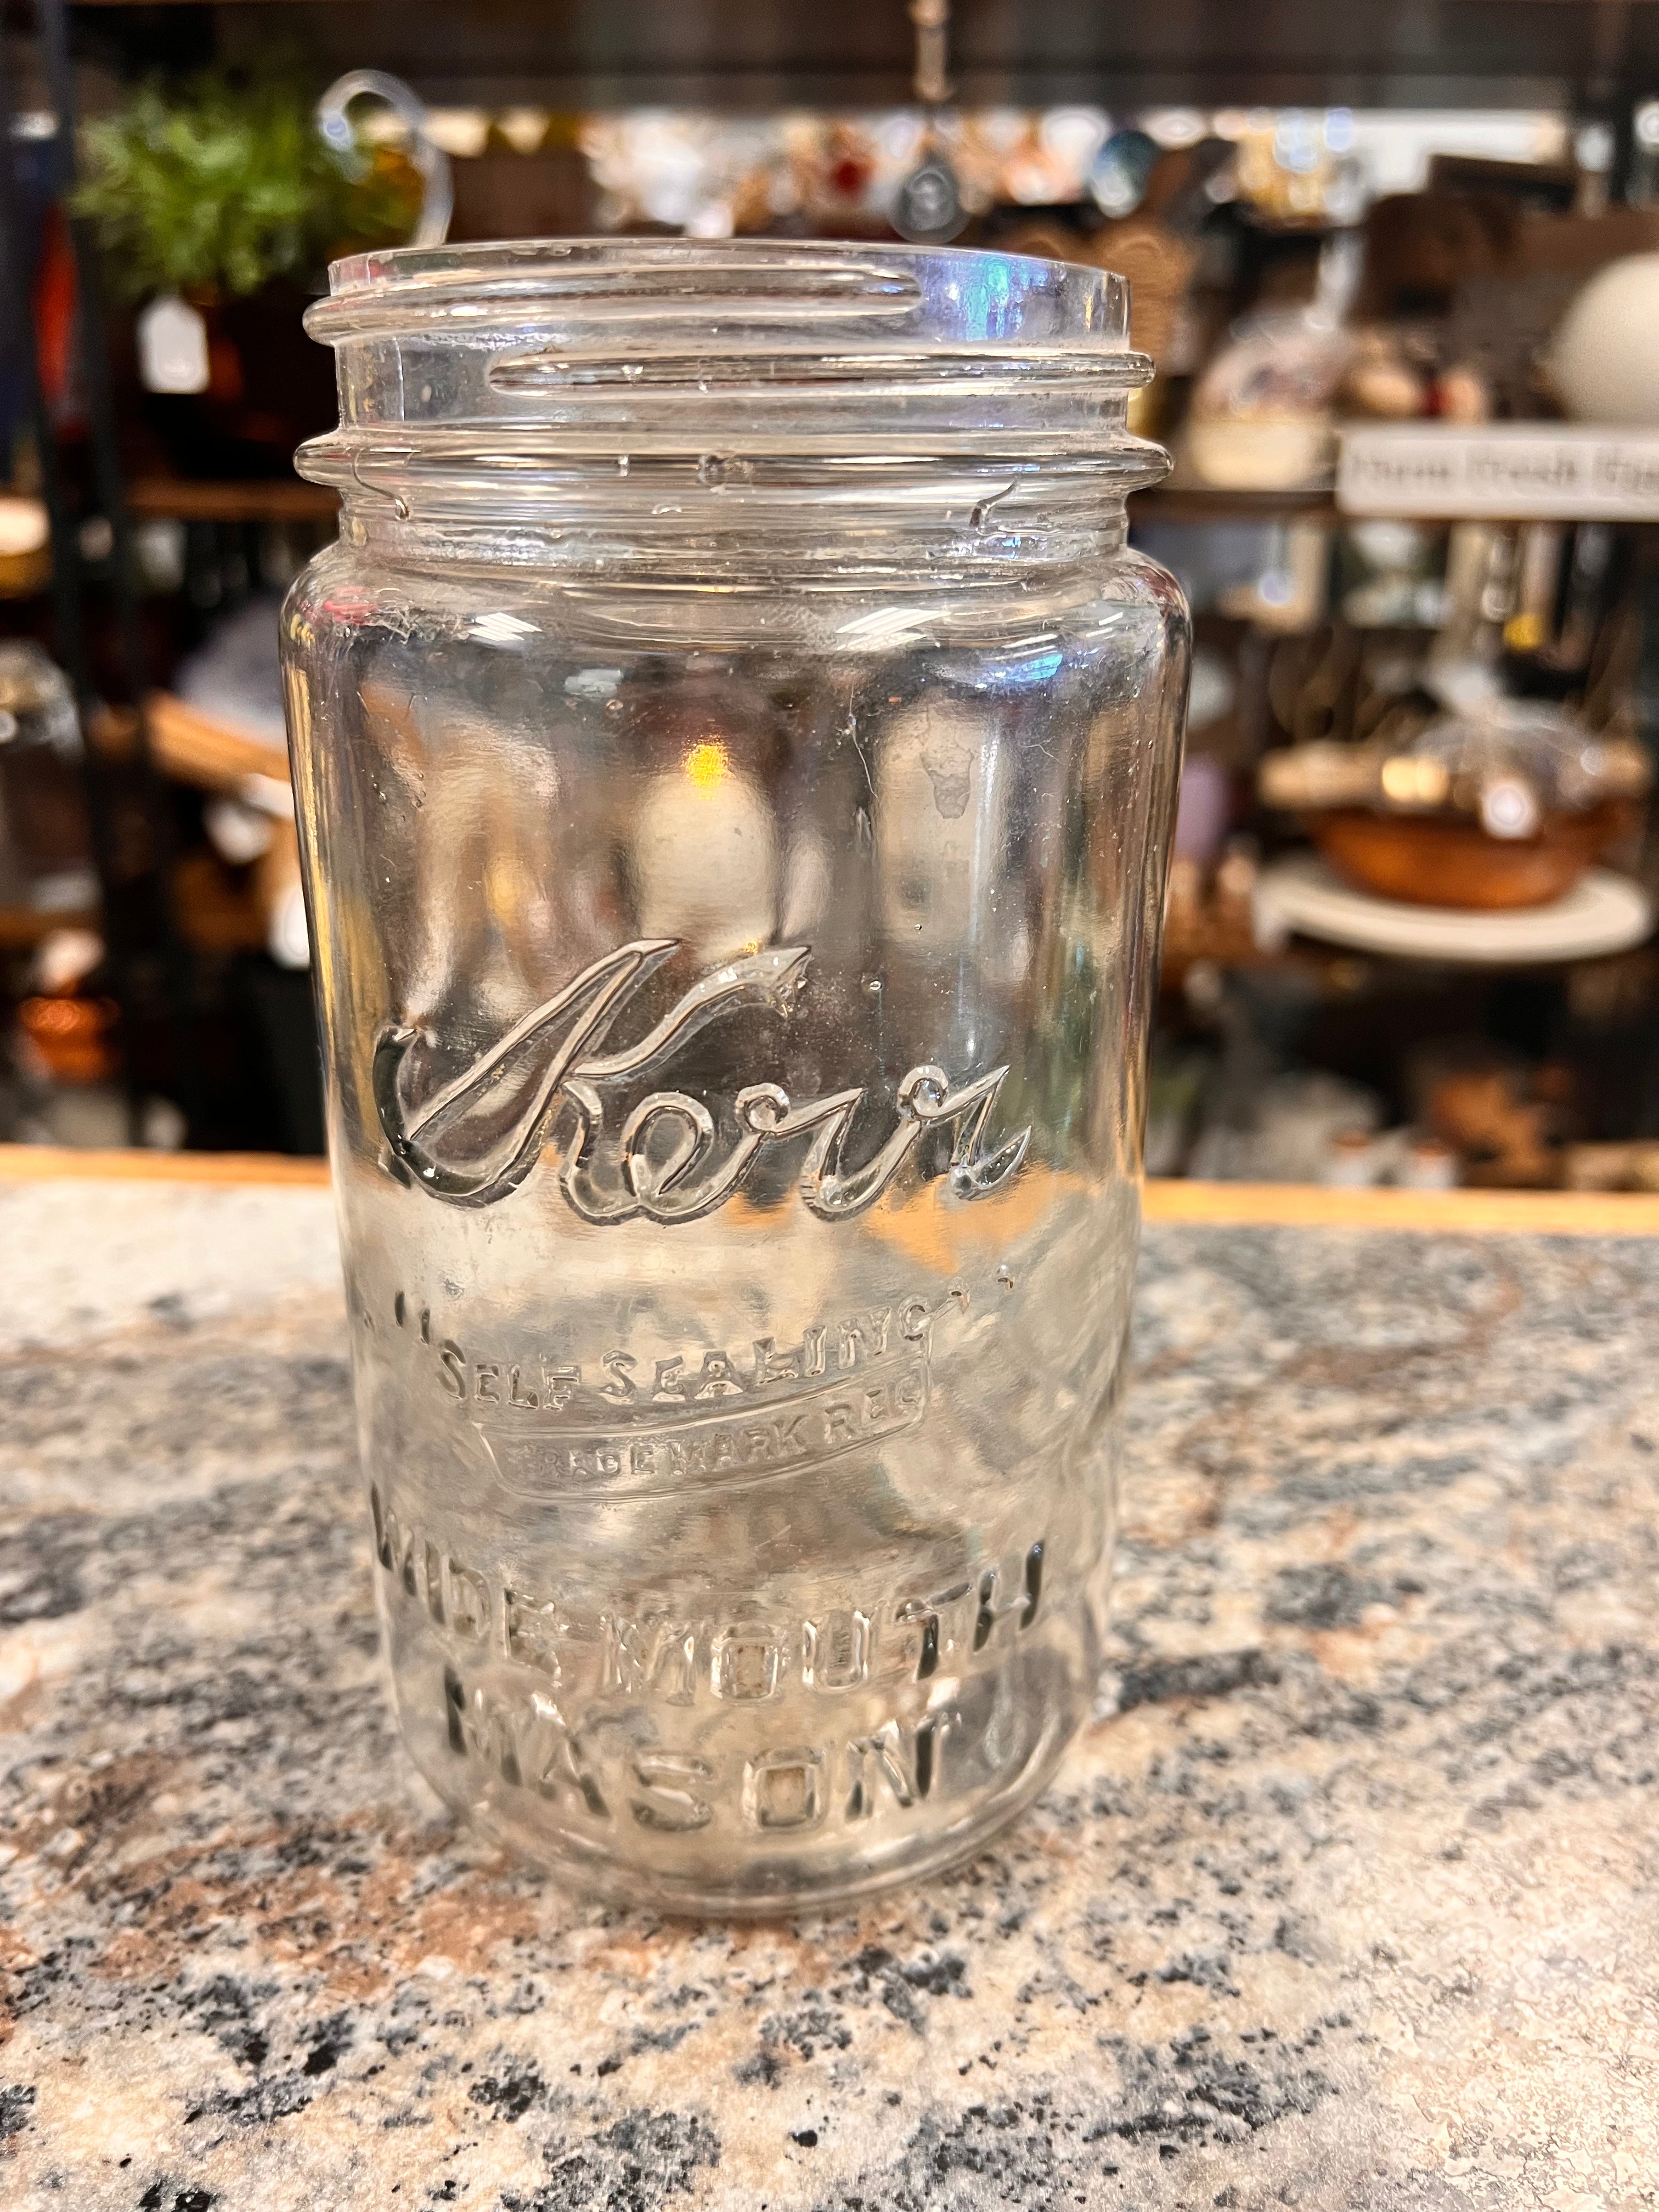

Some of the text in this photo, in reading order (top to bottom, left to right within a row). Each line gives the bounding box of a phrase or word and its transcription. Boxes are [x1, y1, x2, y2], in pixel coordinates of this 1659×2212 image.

[372, 936, 1031, 1226] Kerr
[600, 1539, 1047, 1705] MOUTH
[442, 1664, 952, 1831] MASON
